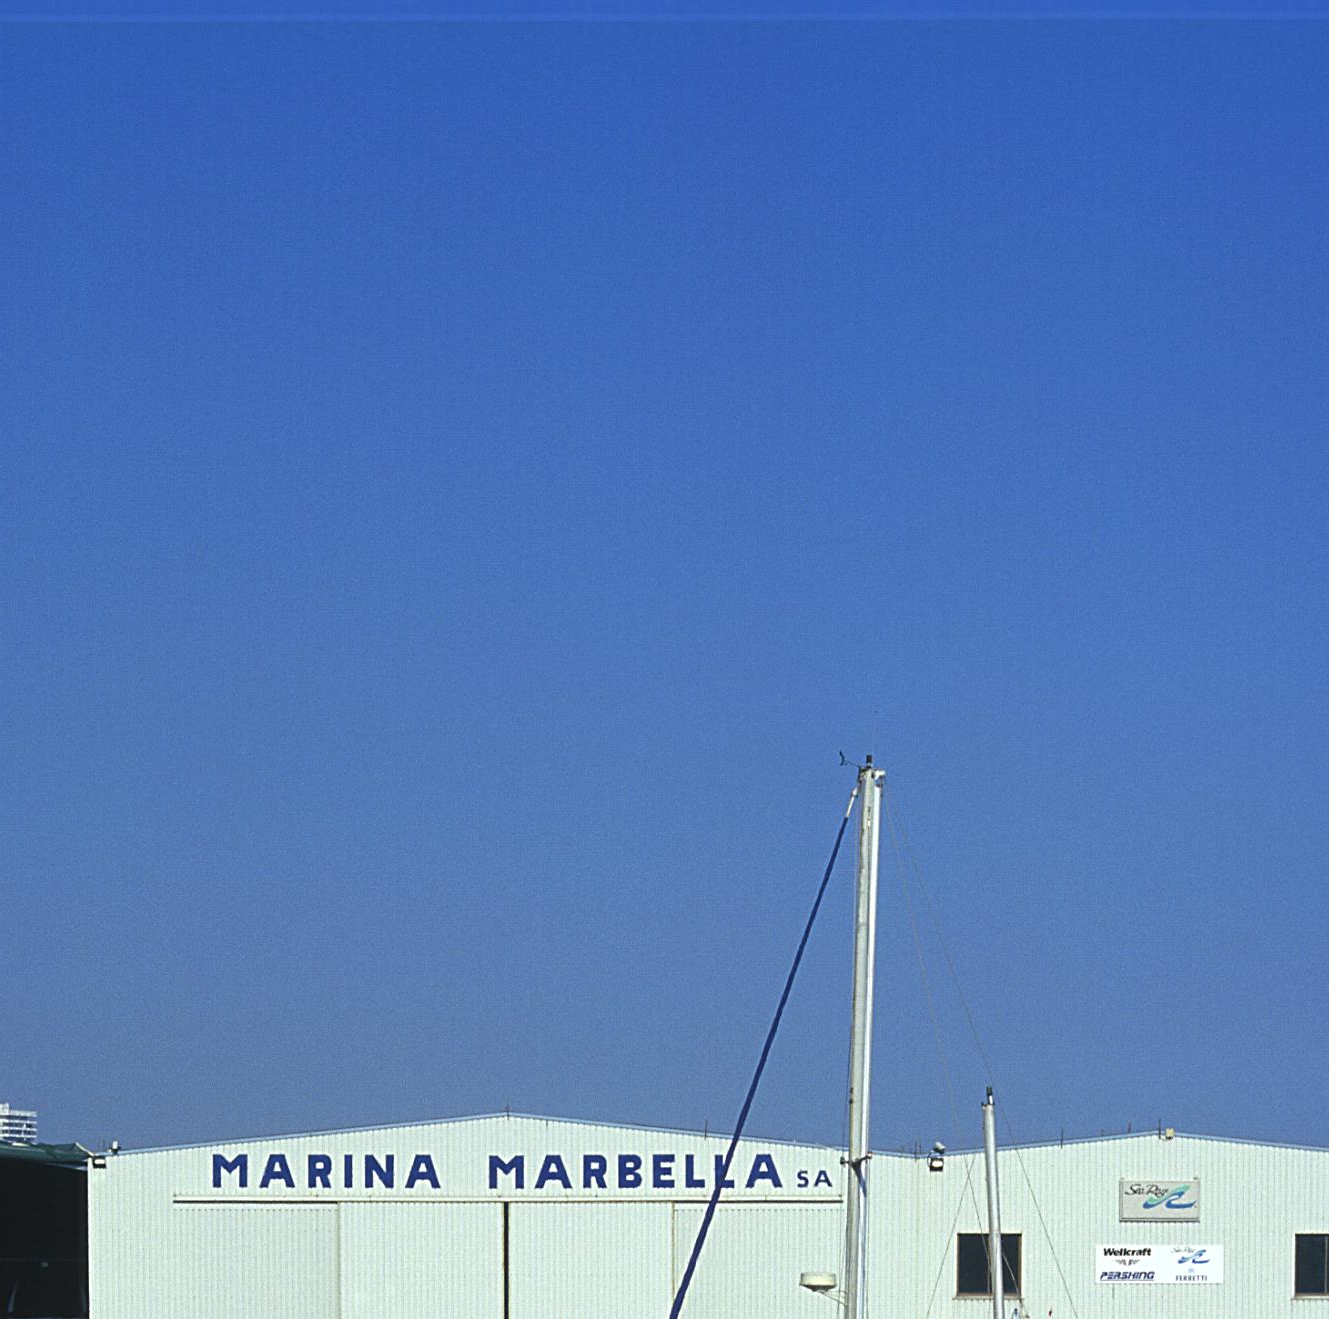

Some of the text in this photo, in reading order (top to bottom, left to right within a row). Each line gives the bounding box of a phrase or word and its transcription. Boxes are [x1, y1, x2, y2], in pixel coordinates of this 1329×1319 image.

[212, 1153, 833, 1189] MARINA MARBELLA SA
[1100, 1271, 1155, 1281] PERSHING
